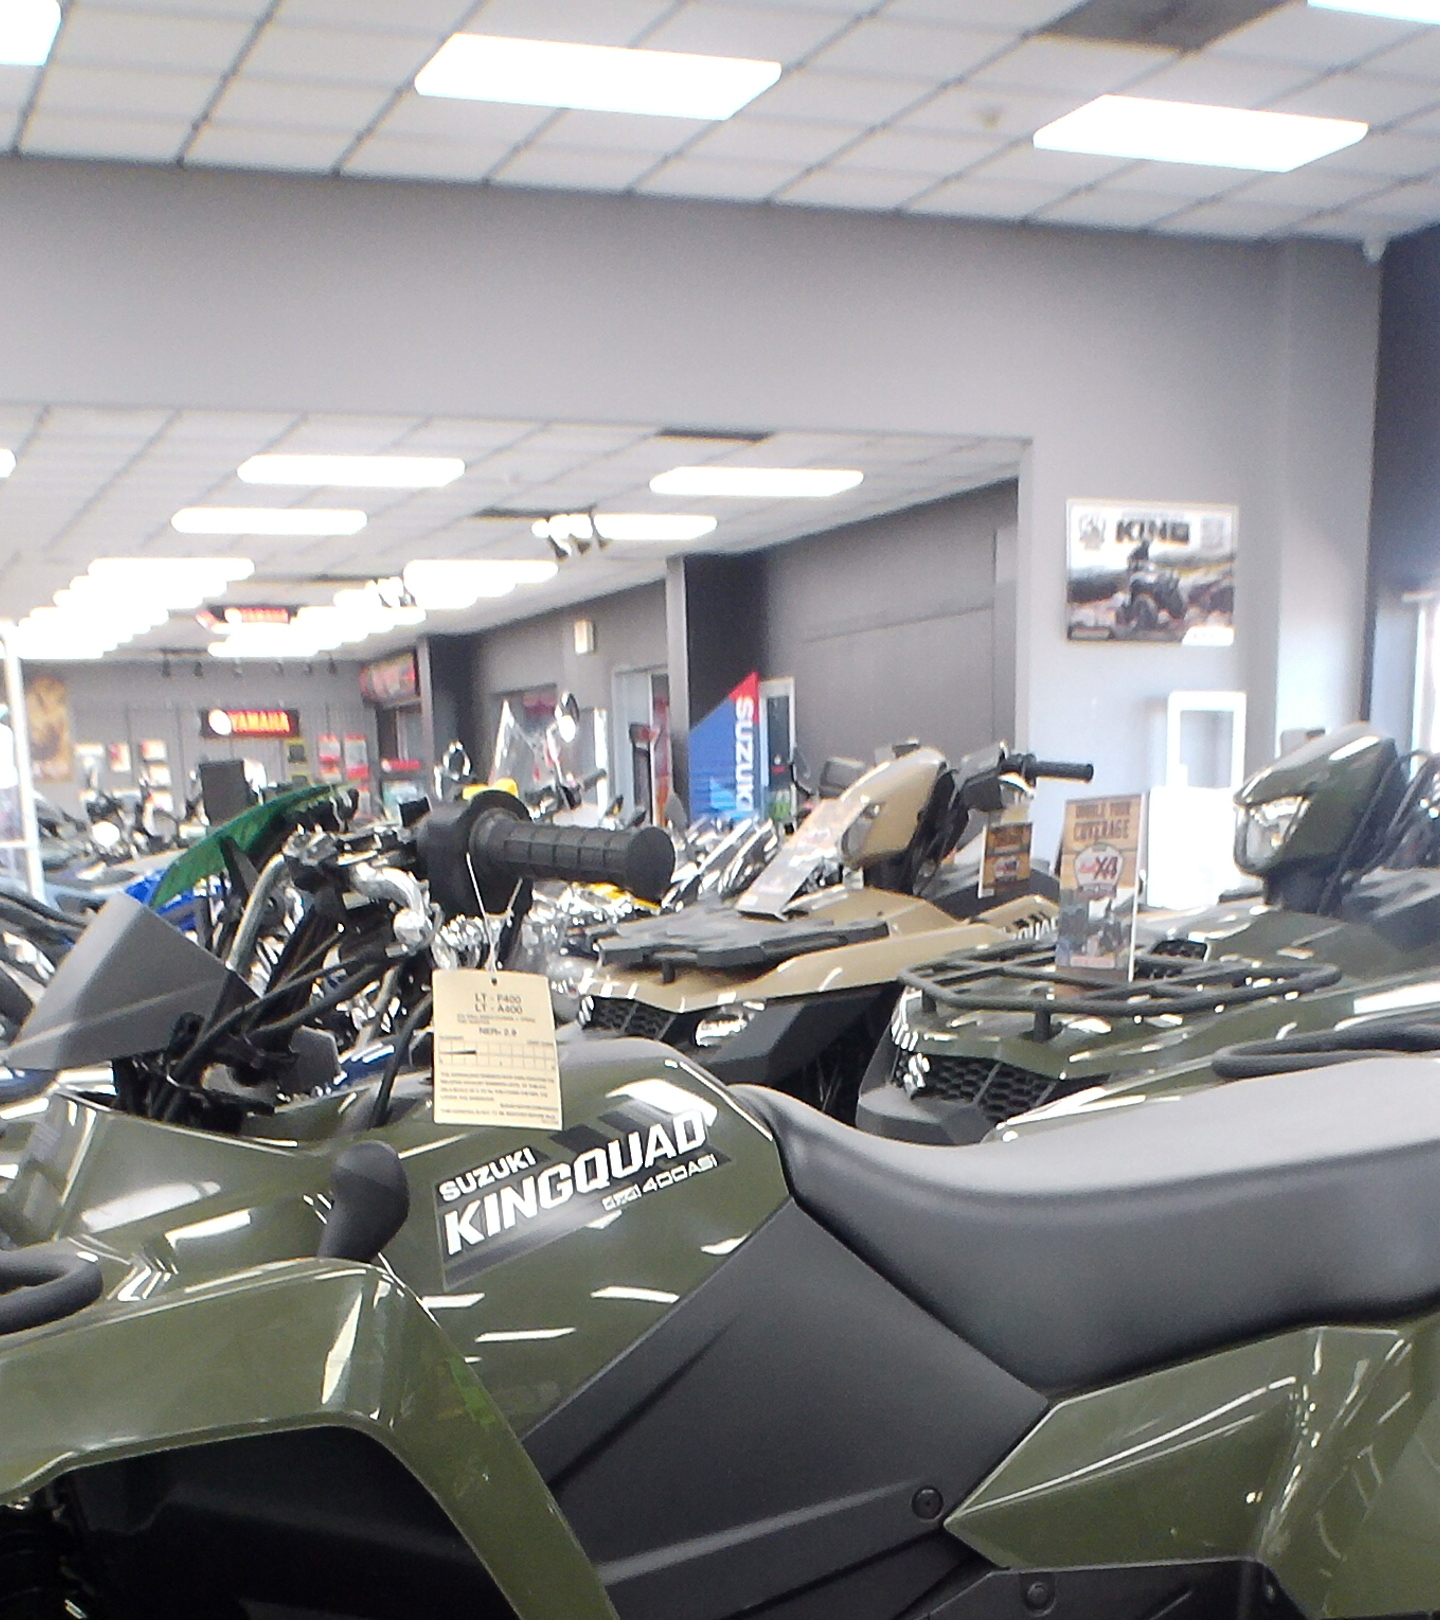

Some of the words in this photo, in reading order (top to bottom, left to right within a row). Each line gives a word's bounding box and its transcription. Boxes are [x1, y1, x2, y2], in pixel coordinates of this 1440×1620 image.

[228, 709, 290, 733] YAMAHA
[438, 1146, 537, 1202] SUZUKI
[444, 1109, 708, 1256] KINGQUAD
